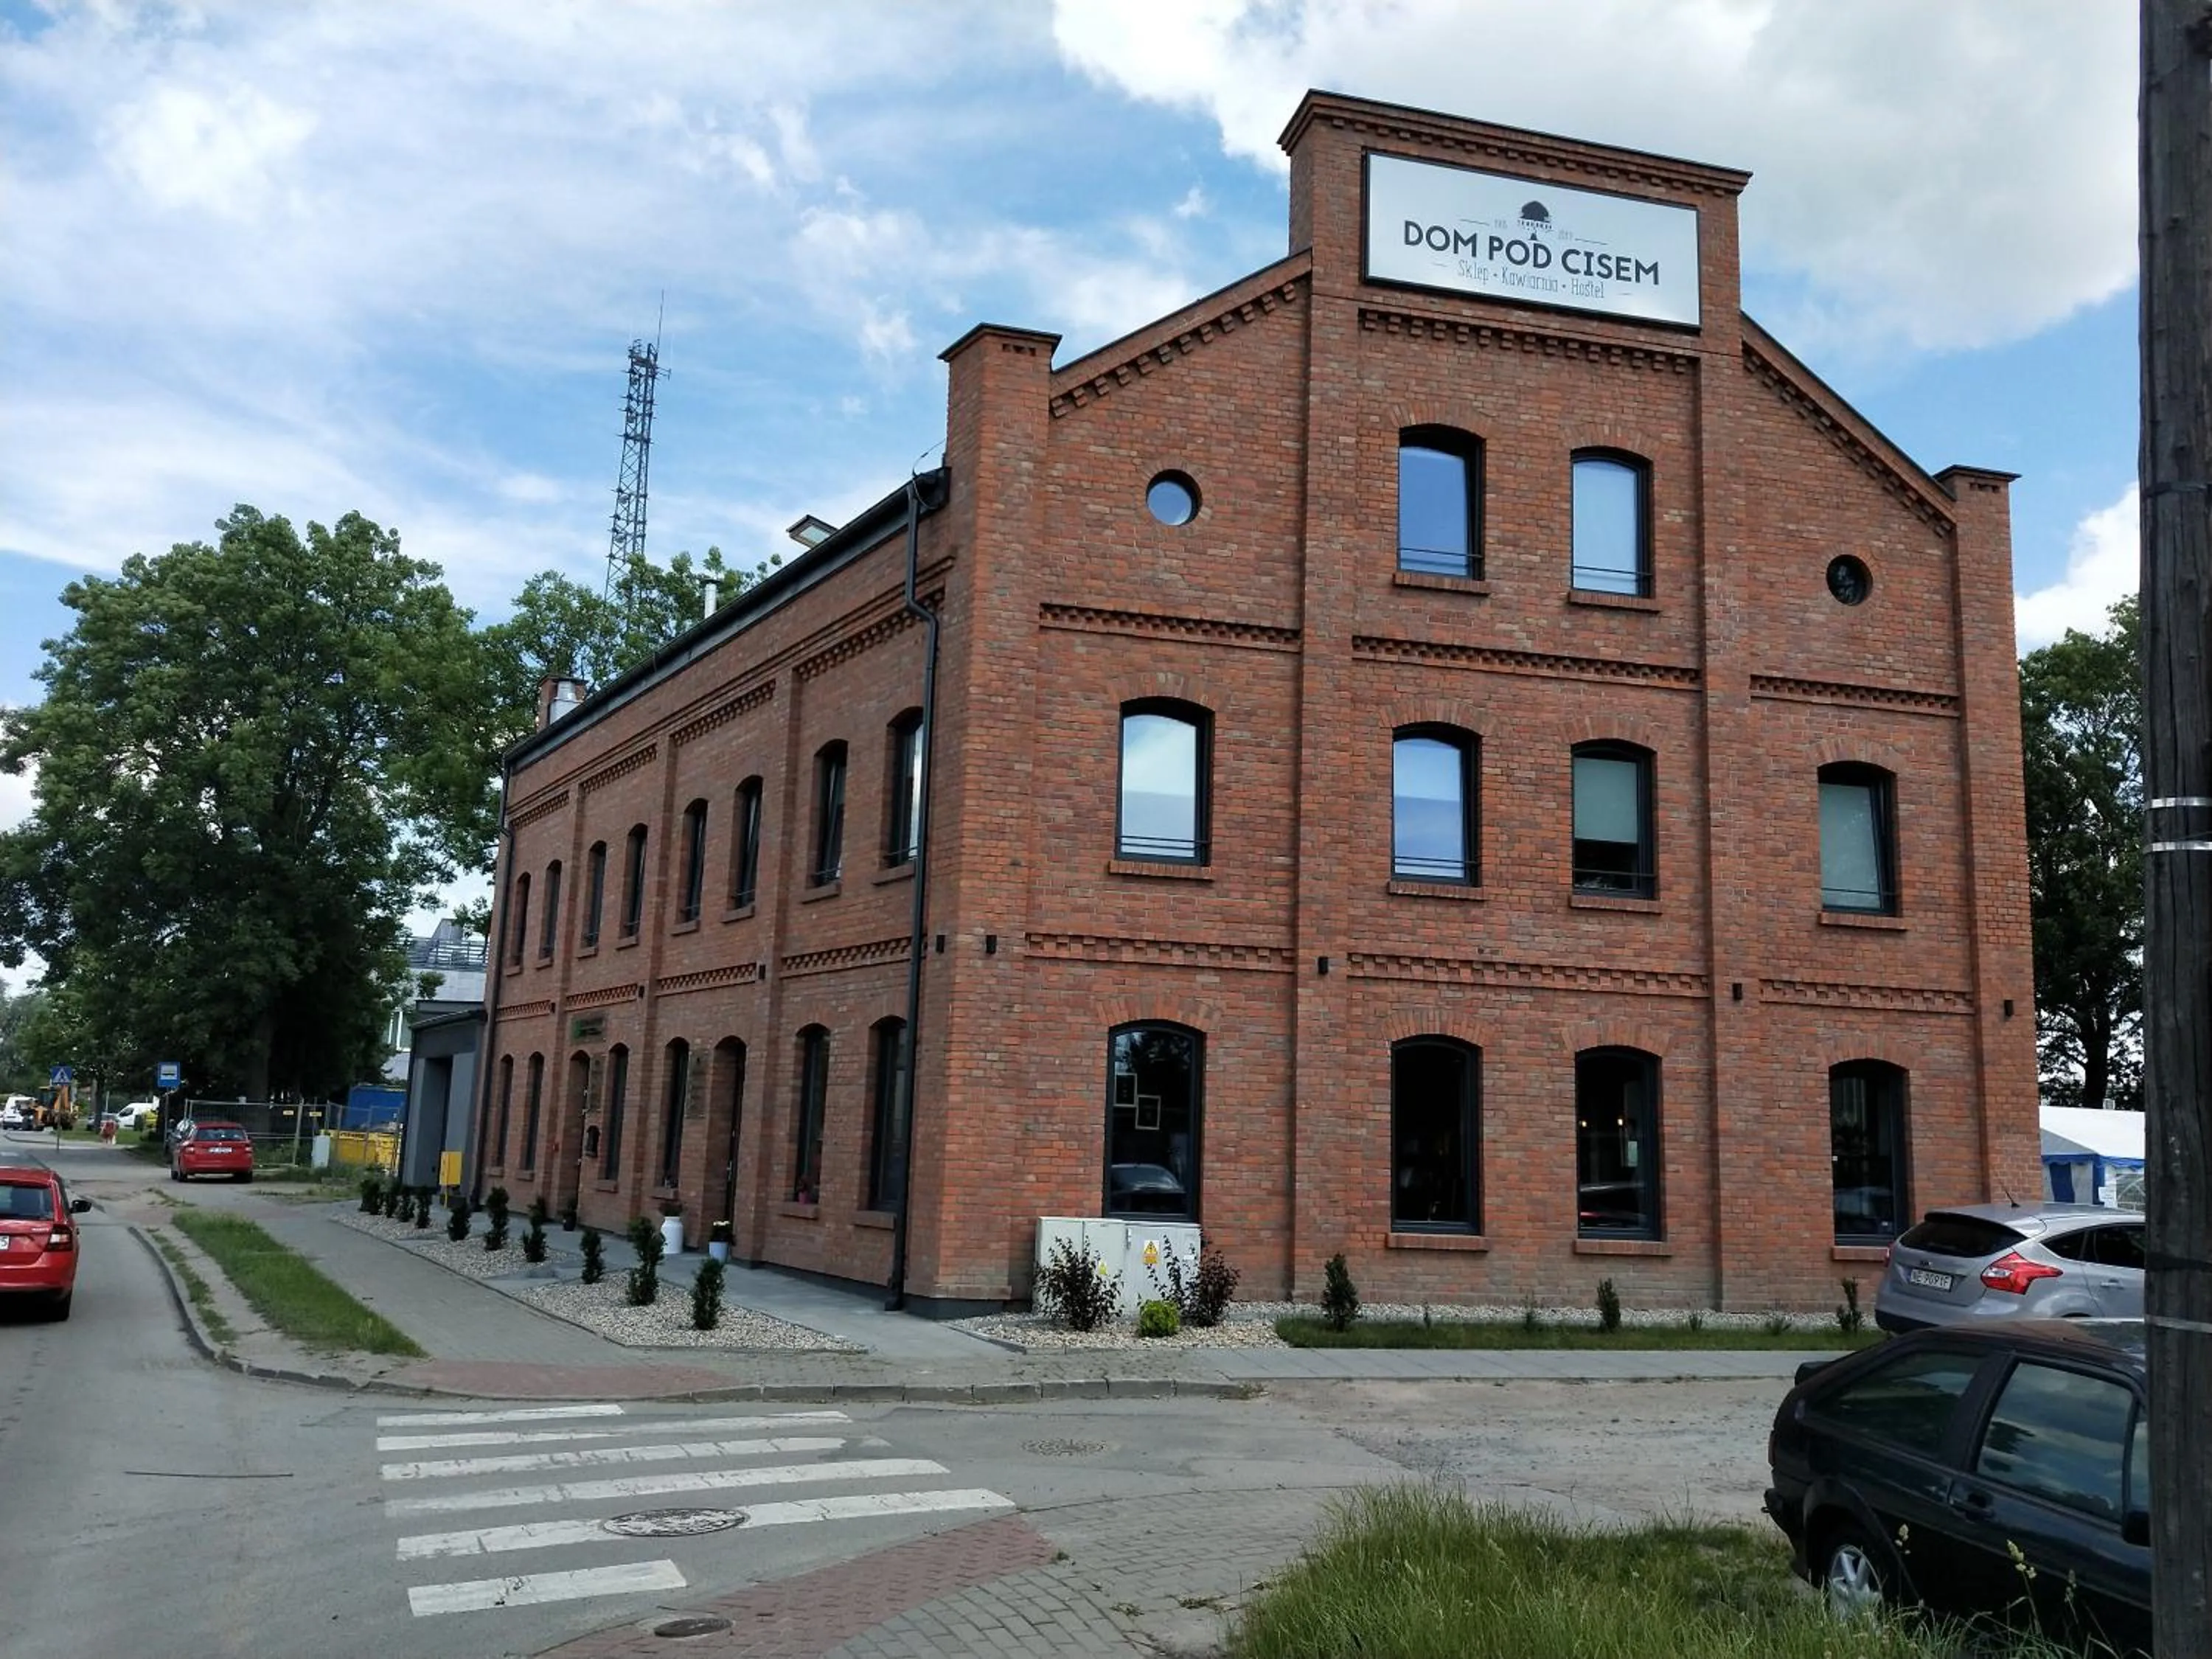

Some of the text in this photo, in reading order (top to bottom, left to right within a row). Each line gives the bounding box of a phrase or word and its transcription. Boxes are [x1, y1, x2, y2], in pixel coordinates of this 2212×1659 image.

[1405, 220, 1659, 285] DOM POD CISEM
[1458, 259, 1605, 298] Sklep Kawiarnia Hostel
